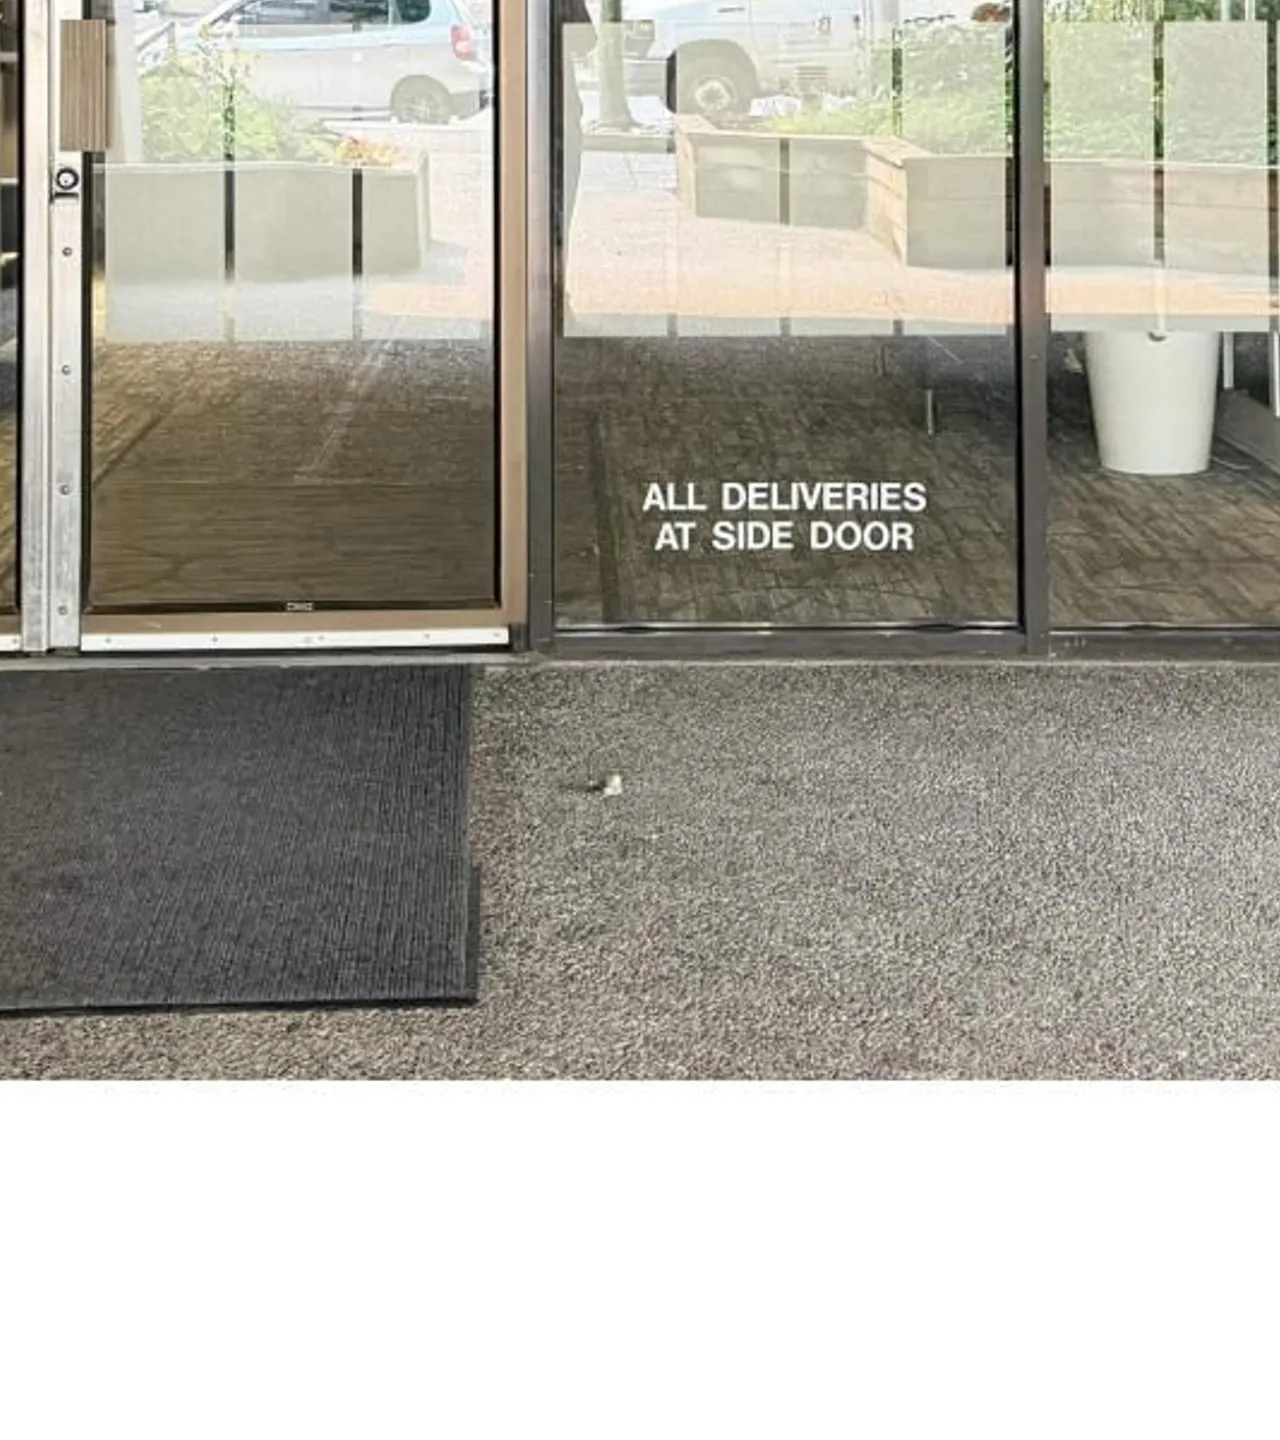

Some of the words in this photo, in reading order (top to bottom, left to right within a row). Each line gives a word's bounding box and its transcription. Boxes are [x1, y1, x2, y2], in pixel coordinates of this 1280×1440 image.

[642, 482, 707, 511] ALL
[721, 481, 928, 511] DELIVERIES
[654, 521, 696, 551] AT
[711, 520, 794, 551] SIDE
[809, 520, 915, 551] DOOR
